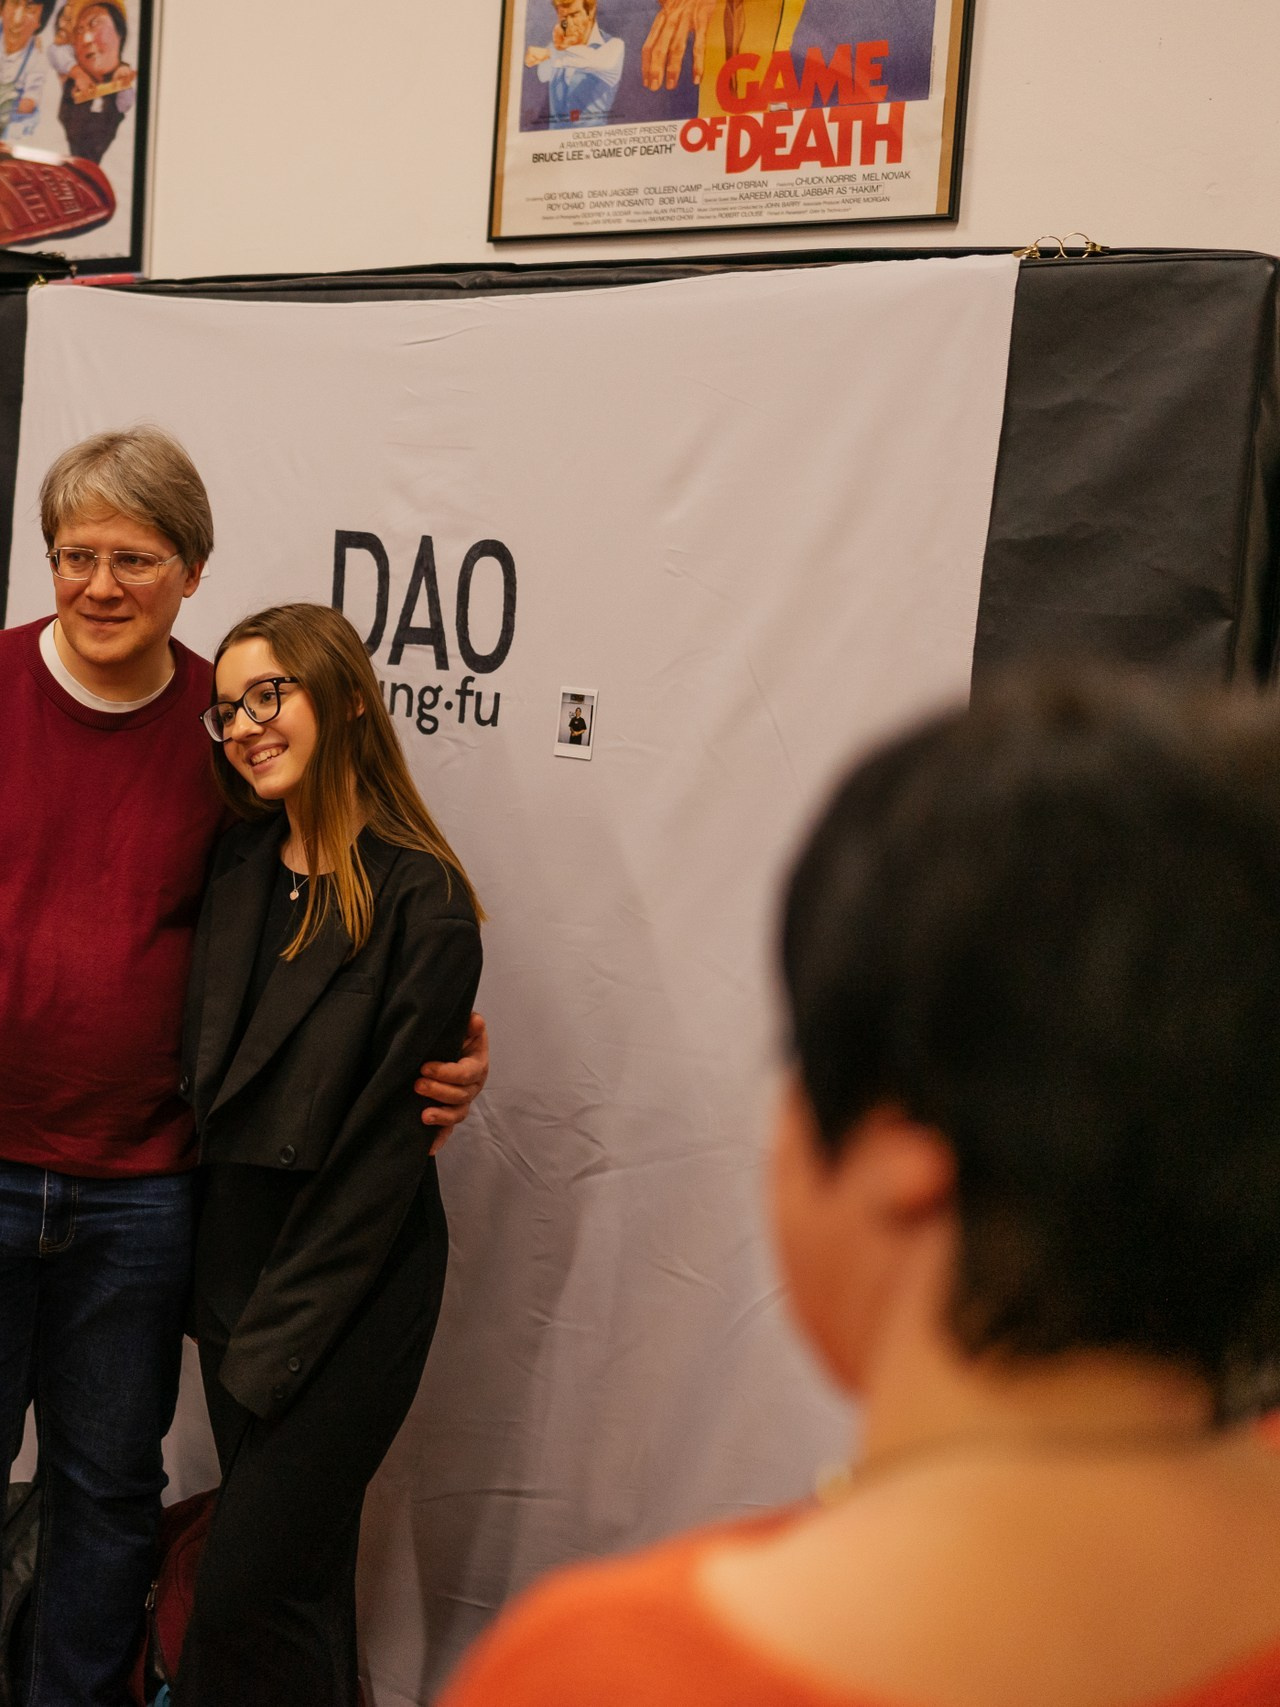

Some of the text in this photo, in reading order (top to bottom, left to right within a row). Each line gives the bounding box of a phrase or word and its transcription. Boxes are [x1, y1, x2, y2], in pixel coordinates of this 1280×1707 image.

[716, 39, 889, 114] GAME
[572, 124, 678, 140] GOLDEN HARVEST PRESENTS
[679, 101, 906, 174] OF DEATH
[559, 134, 676, 150] A RAYMOND CHOW PRODUCTION
[532, 151, 564, 163] BRUCE
[566, 150, 584, 161] LEE
[624, 146, 637, 157] OF
[544, 192, 557, 201] GIG
[558, 191, 584, 200] YOUNG
[587, 190, 608, 199] DEAN
[608, 188, 639, 198] JAGGER
[643, 185, 678, 196] COLLEEN
[678, 183, 703, 194] CAMP
[711, 181, 736, 191] HUGH
[736, 179, 769, 190] O'BRIAN
[794, 176, 824, 186] CHUCK
[825, 174, 857, 185] NORRIS
[861, 172, 881, 183] MEL
[881, 170, 911, 181] NOVAK
[738, 190, 772, 201] KAREEM
[772, 188, 800, 199] ABDUL
[800, 187, 834, 198] JABBAR
[835, 185, 847, 195] AS
[848, 184, 883, 195] "HAKIM"
[546, 202, 562, 211] ROY
[589, 200, 616, 210] DANNY
[616, 198, 655, 208] INOSANTO
[658, 196, 676, 206] BOB
[676, 195, 698, 204] WALL
[331, 529, 517, 674] DAO
